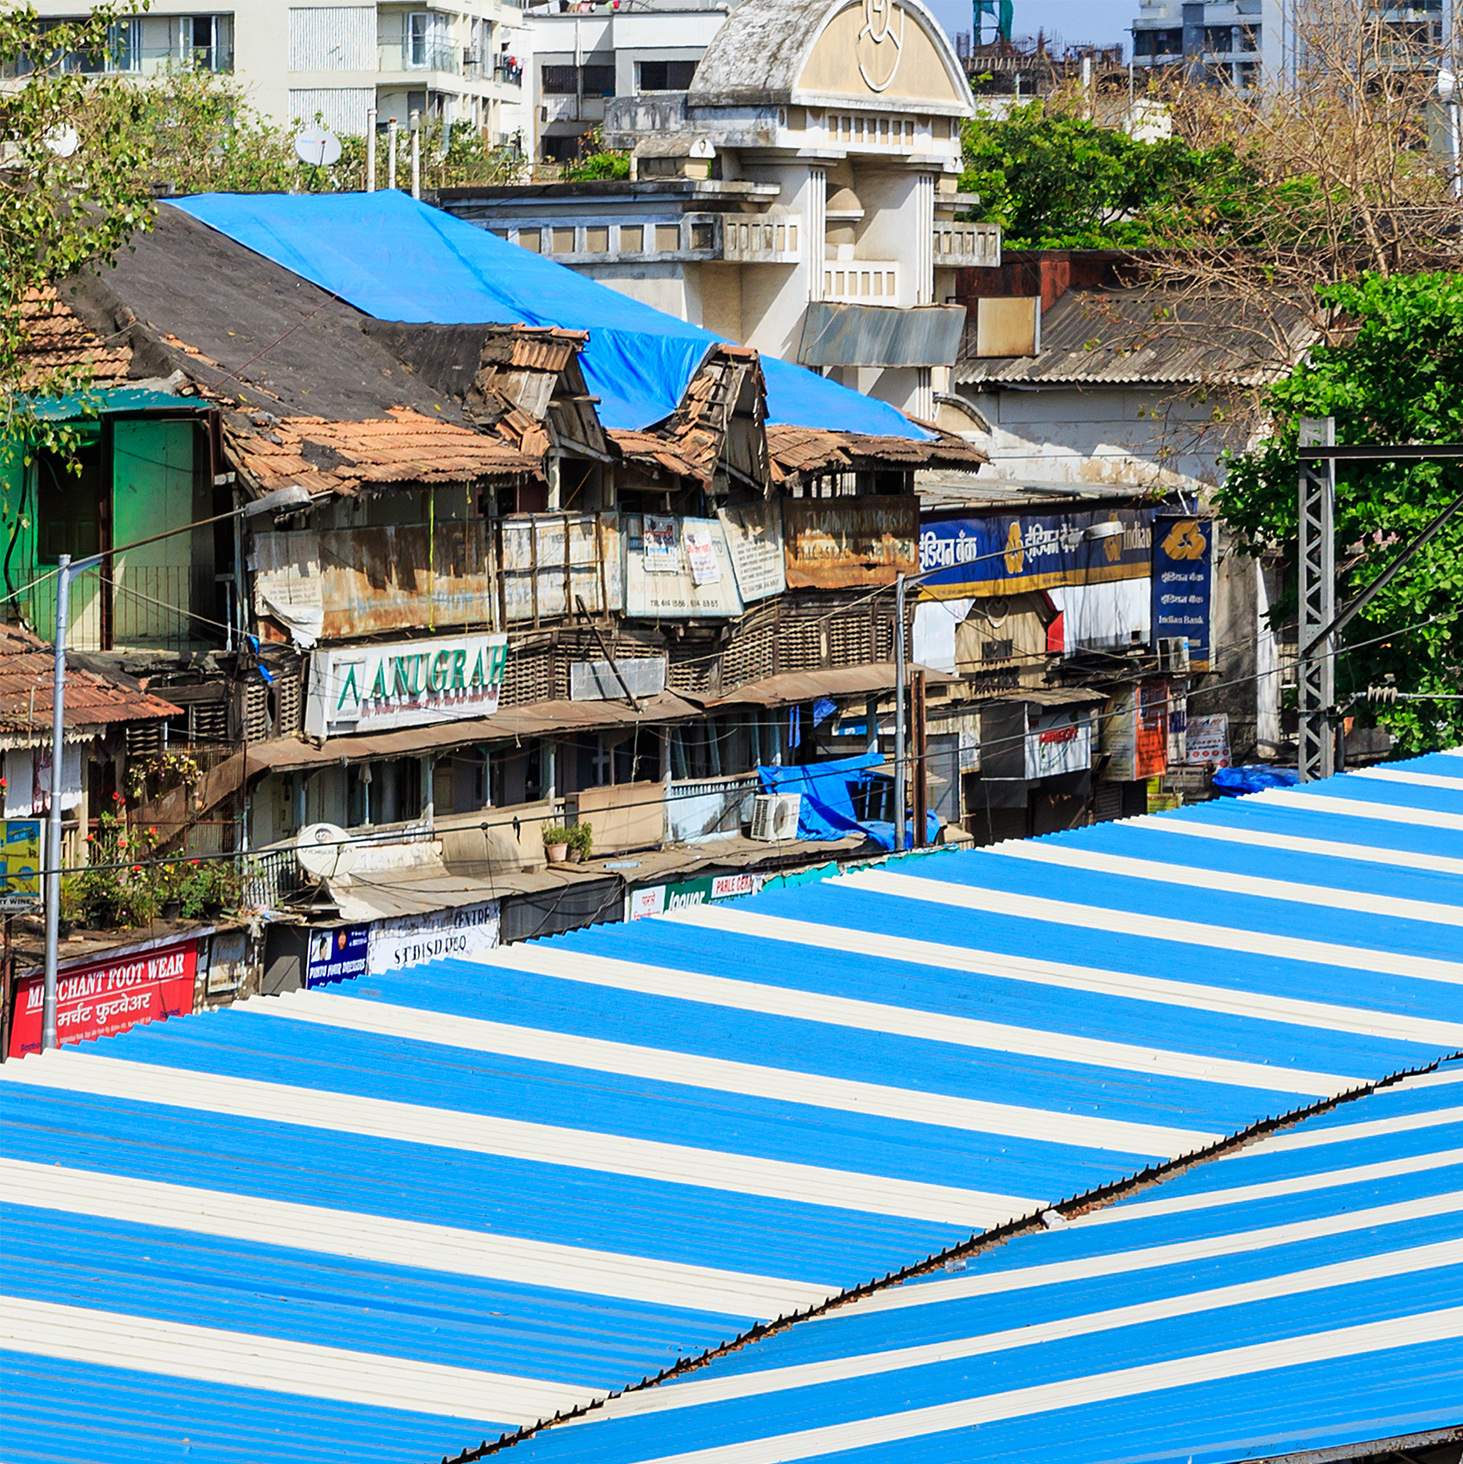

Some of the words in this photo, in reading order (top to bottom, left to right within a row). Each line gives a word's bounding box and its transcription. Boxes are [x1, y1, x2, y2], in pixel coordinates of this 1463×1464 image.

[368, 643, 508, 699] ANUGRAH
[107, 961, 144, 988] FOOT
[148, 953, 184, 979] WEAR
